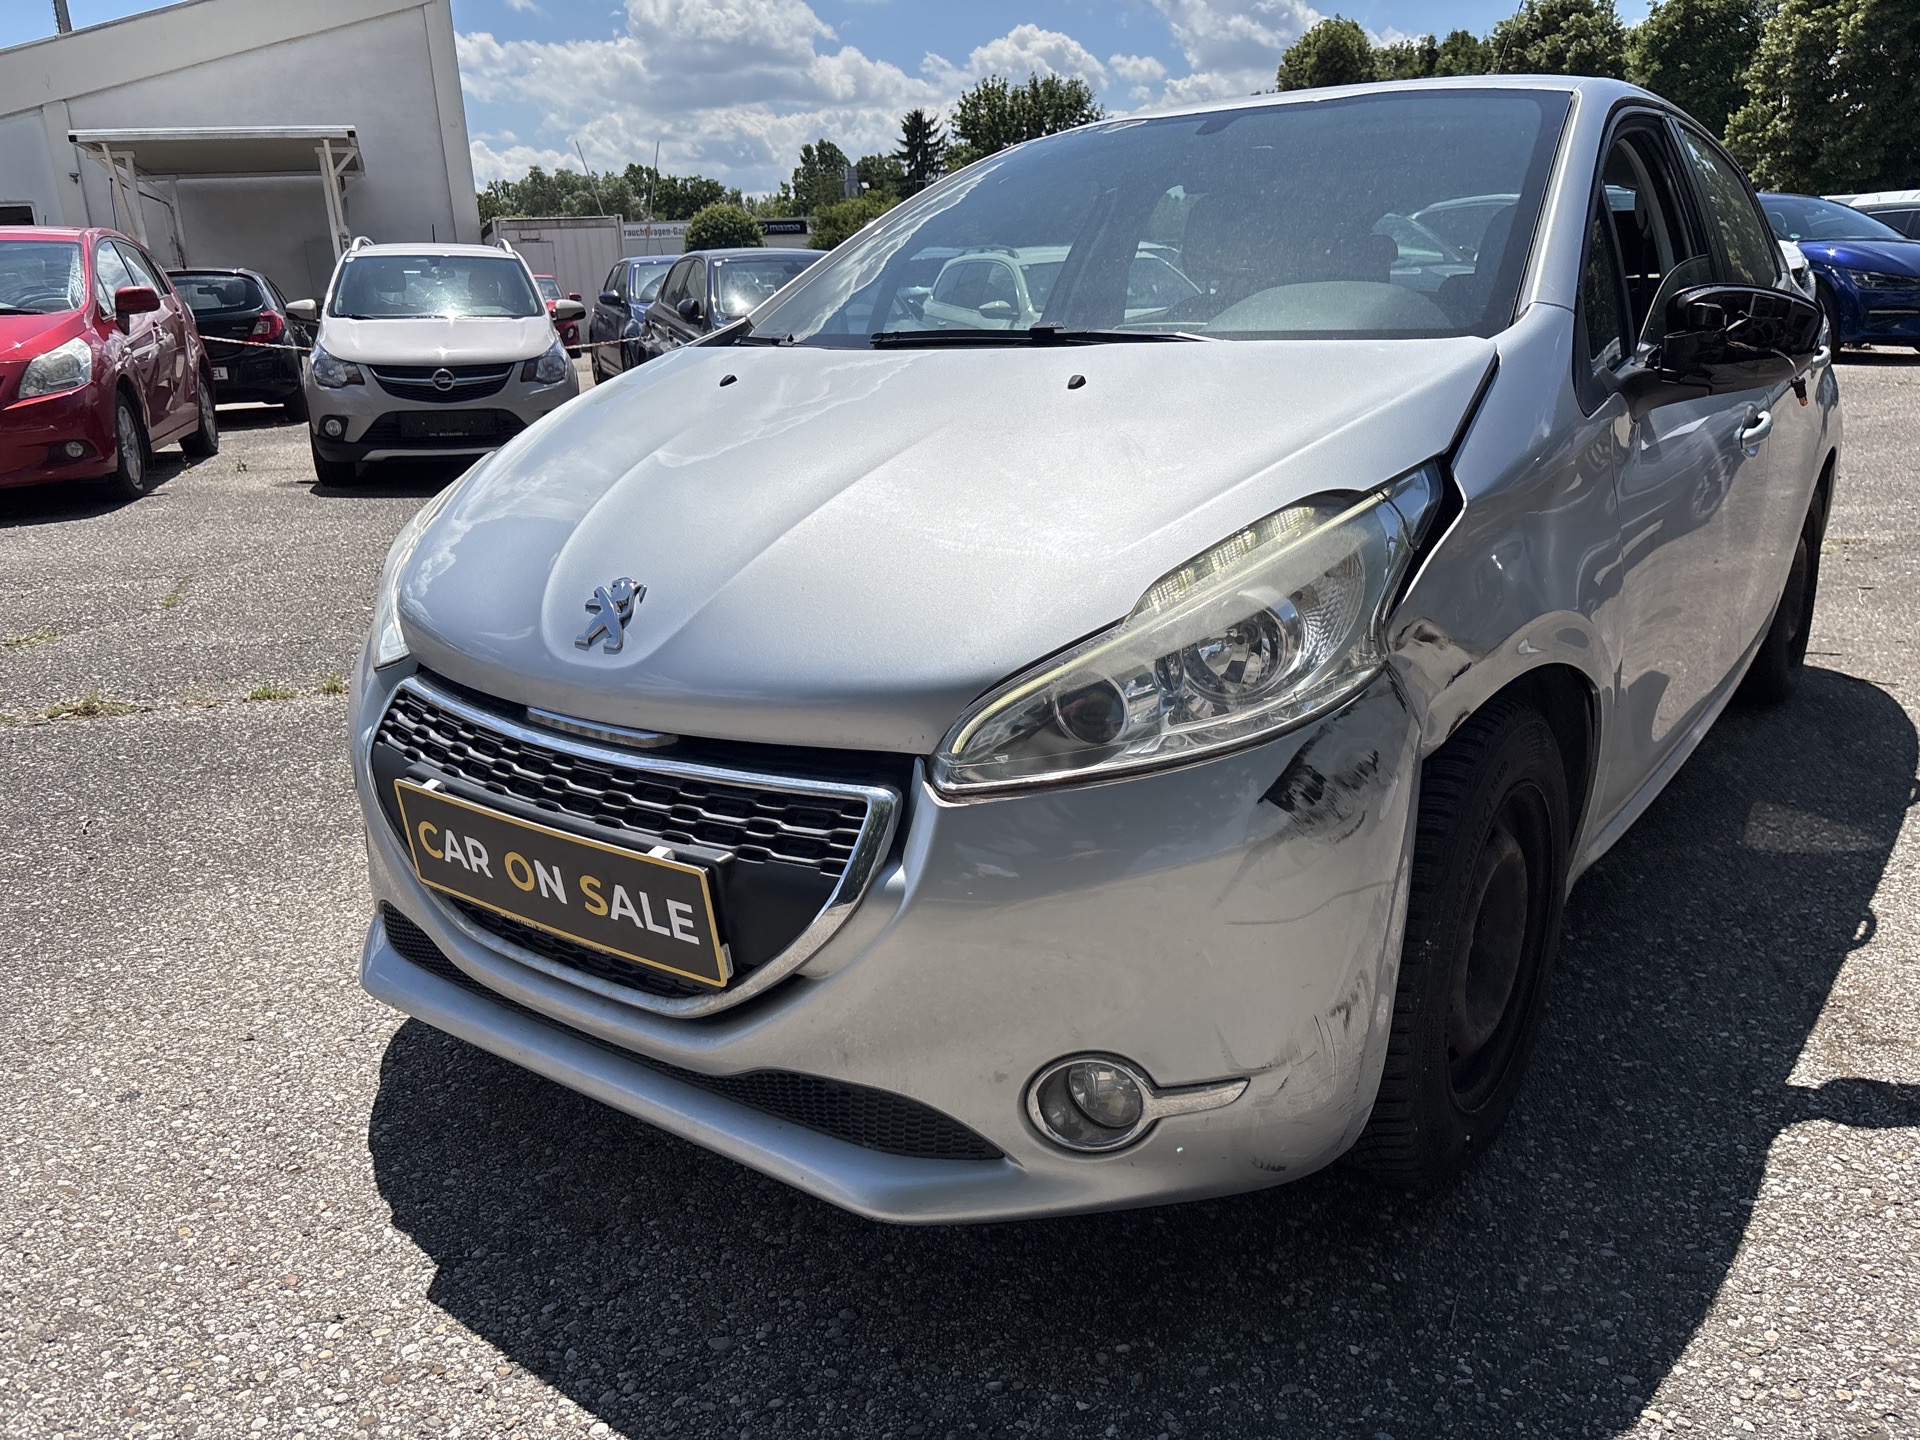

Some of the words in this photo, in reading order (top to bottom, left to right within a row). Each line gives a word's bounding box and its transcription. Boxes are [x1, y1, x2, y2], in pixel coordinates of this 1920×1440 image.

[769, 224, 801, 232] mazda
[418, 821, 494, 879] CAR
[504, 851, 568, 905] ON
[579, 875, 700, 946] SALE
[1438, 796, 1492, 978] interContact
